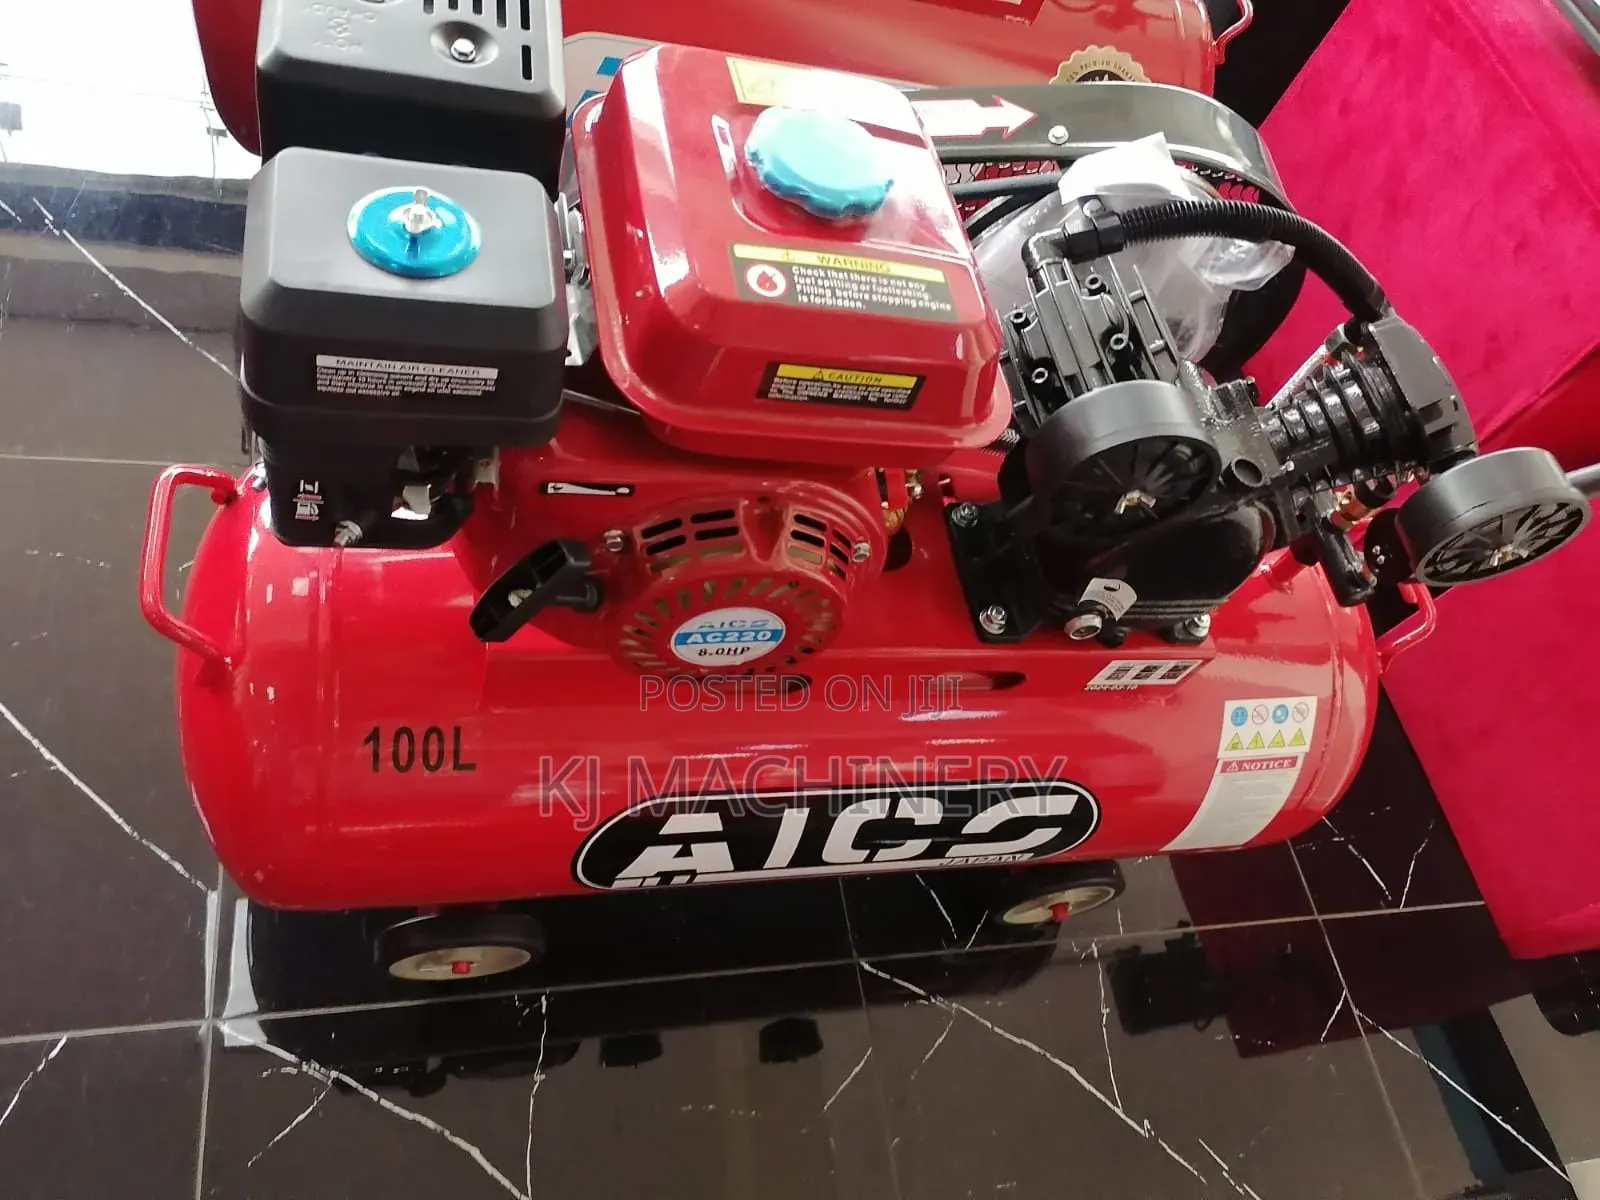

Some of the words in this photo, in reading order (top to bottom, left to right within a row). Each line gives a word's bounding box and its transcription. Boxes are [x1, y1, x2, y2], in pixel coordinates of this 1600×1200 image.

[816, 254, 890, 272] WARNING
[792, 266, 825, 278] Check
[827, 268, 849, 279] that
[850, 272, 877, 283] there
[890, 279, 907, 288] not
[908, 281, 927, 293] any
[794, 274, 816, 284] fuel
[836, 288, 870, 301] before
[871, 294, 917, 309] stopping
[918, 299, 952, 312] engine
[336, 359, 397, 370] MAINTAIN
[400, 363, 420, 373] AIR
[422, 366, 481, 377] CLEANER
[828, 371, 883, 383] CAUTION
[686, 630, 773, 644] AC220
[698, 646, 751, 657] 8.0HP
[363, 725, 477, 773] 100L
[1240, 759, 1293, 772] NOTICE
